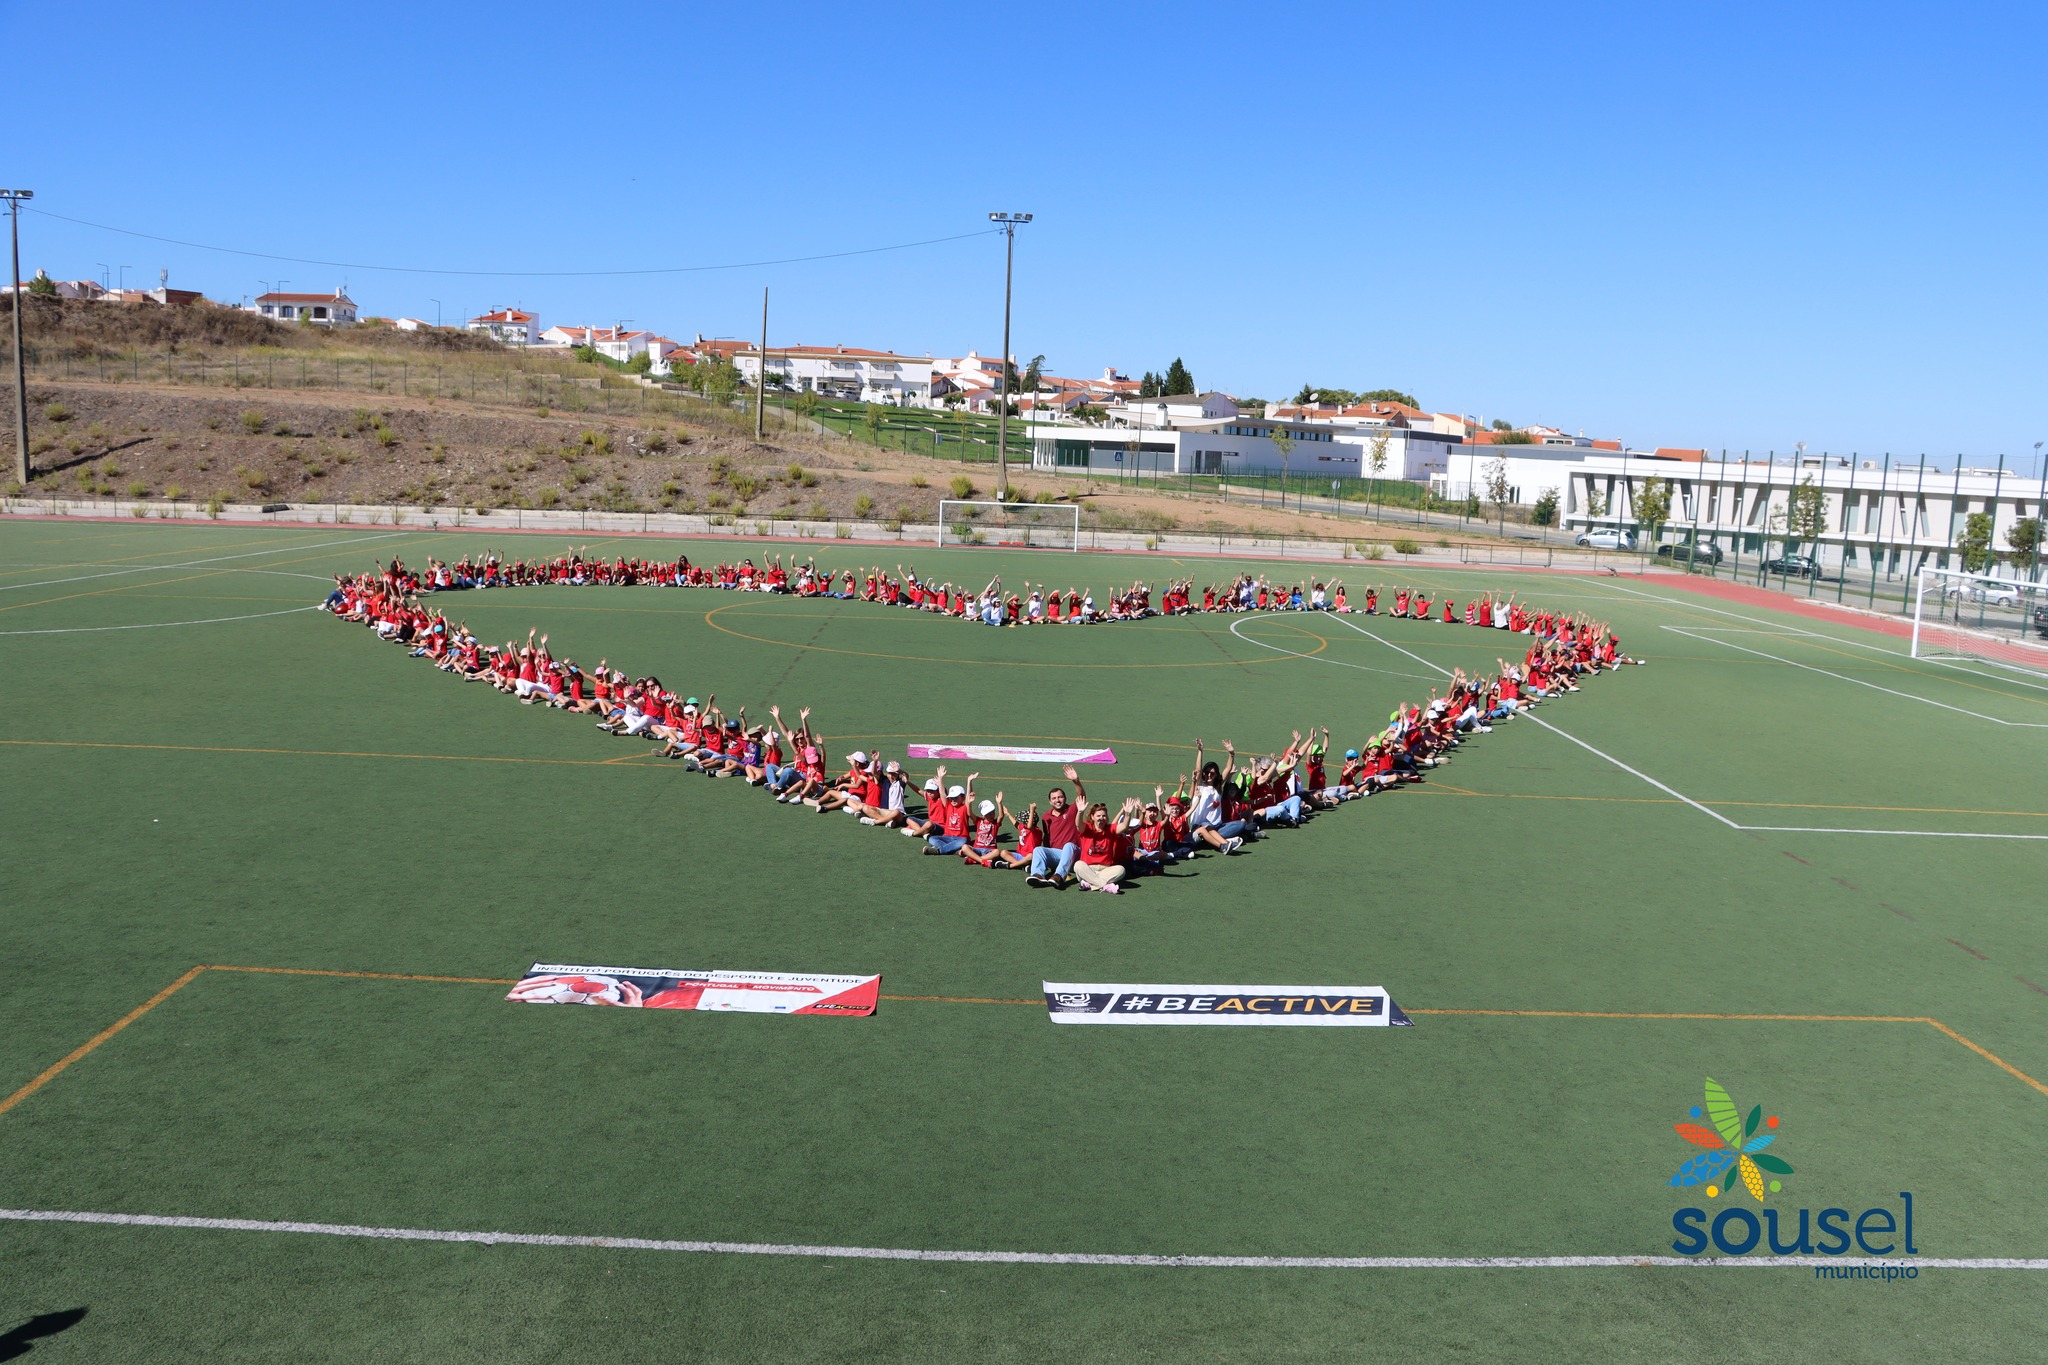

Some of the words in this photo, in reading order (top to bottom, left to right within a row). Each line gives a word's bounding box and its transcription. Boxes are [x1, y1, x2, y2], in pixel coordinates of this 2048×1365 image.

[537, 965, 601, 973] INSTITUTO
[604, 967, 680, 977] PORTUGUÊS
[788, 976, 863, 984] JUVENTUDE
[684, 981, 740, 989] PORTUGAL
[752, 984, 816, 992] MOVIMENTO
[1122, 996, 1374, 1013] #BEACTIVE
